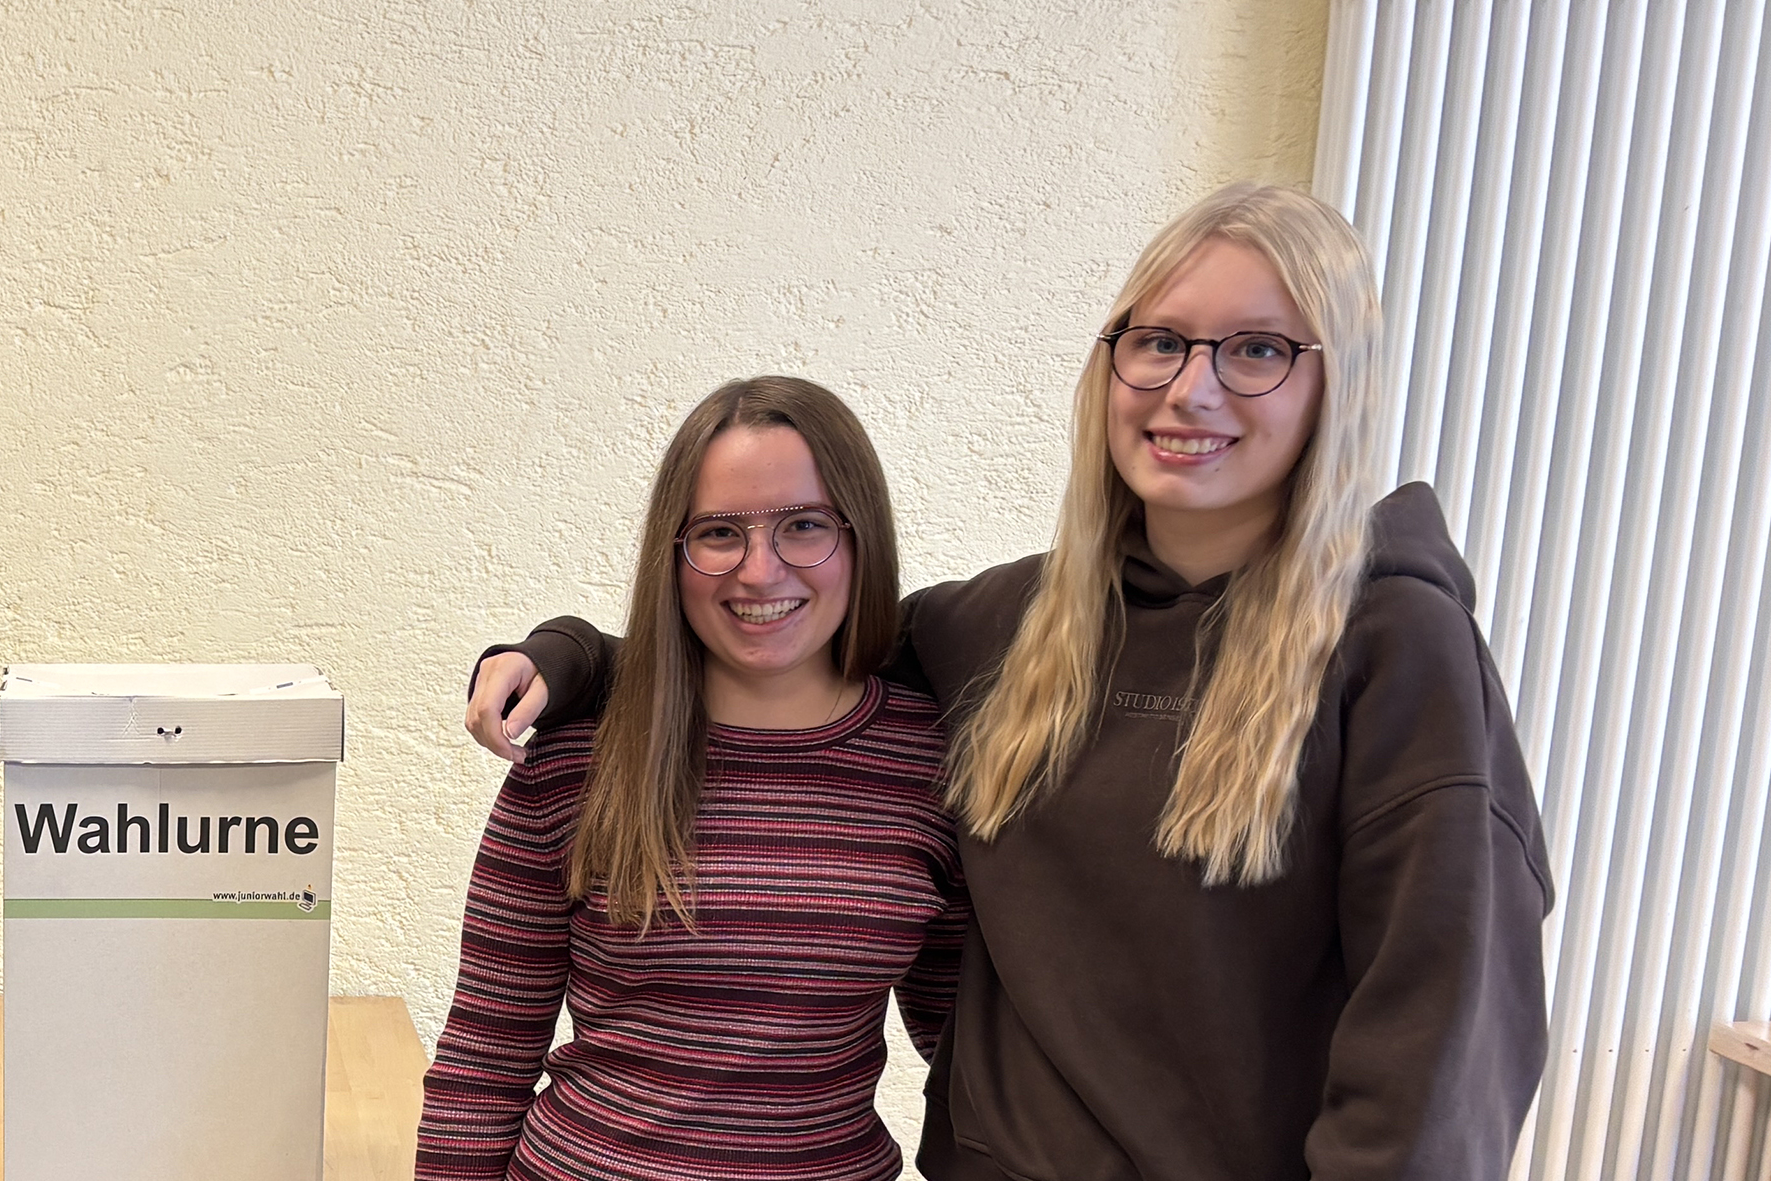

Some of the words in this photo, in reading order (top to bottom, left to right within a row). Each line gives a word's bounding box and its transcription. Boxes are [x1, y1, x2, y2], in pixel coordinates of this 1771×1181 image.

[1113, 691, 1171, 711] STUDIO
[15, 803, 319, 854] Wahlurne
[213, 891, 301, 902] www.juniorwahl.de
